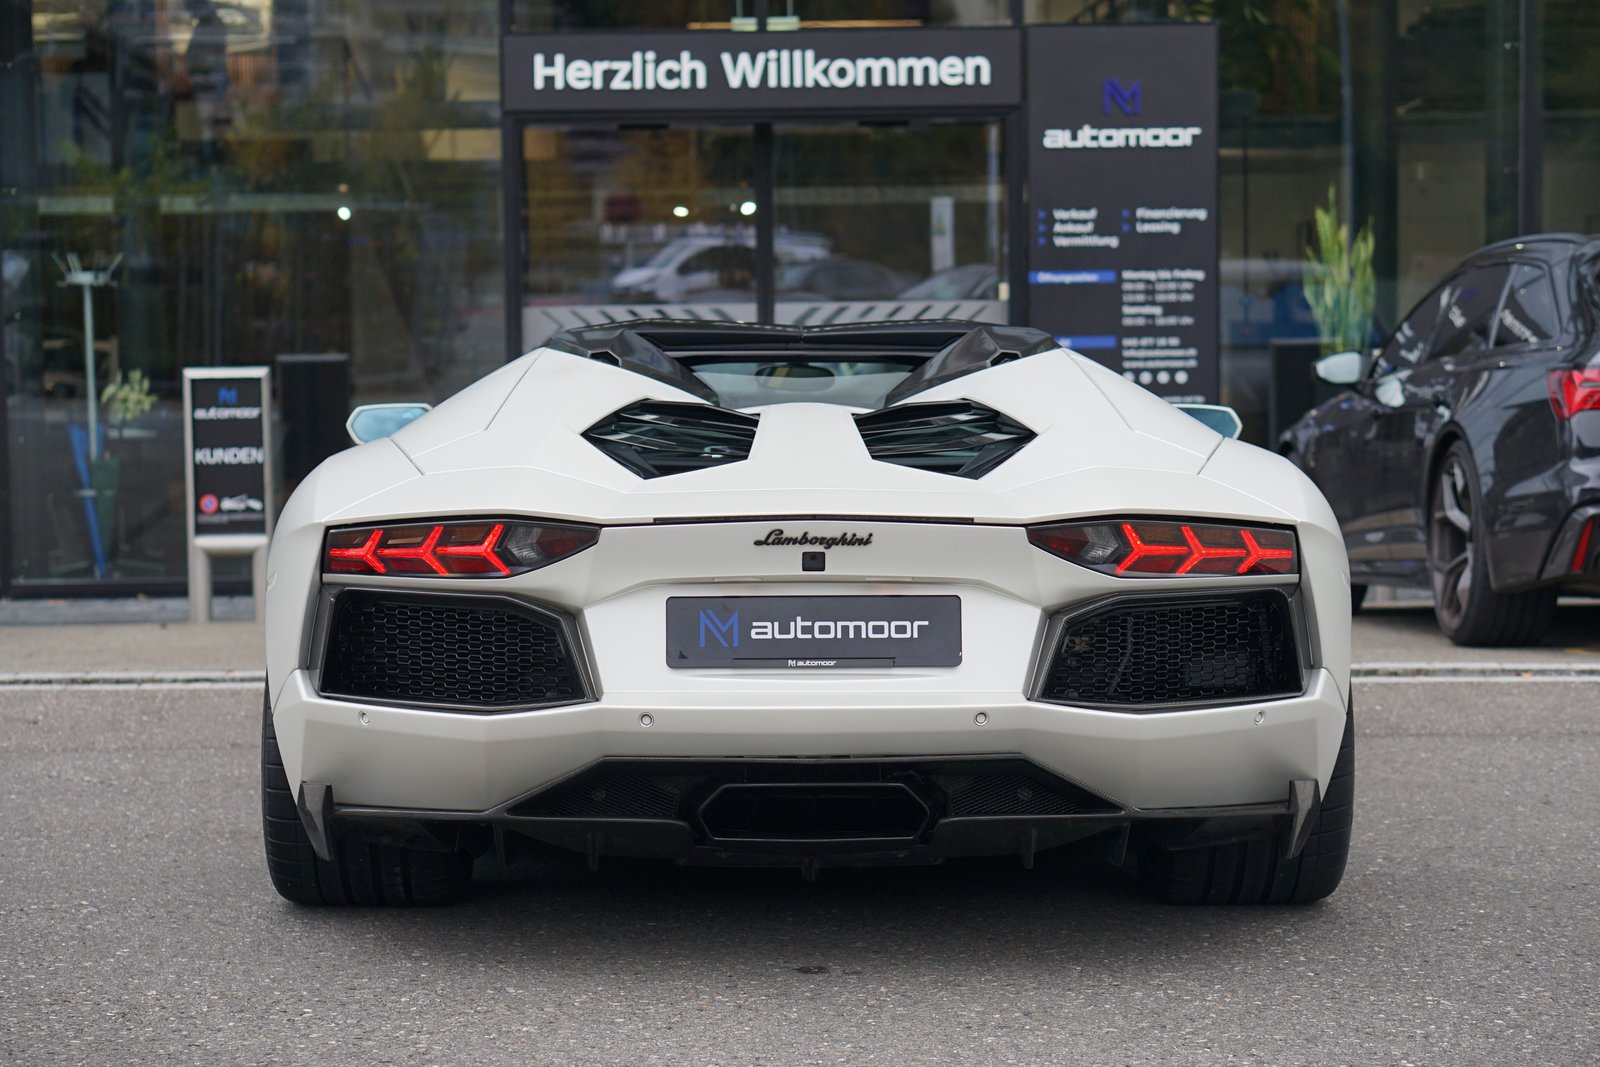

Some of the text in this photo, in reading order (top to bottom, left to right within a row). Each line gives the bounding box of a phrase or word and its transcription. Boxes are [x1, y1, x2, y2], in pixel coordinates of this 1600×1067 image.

[533, 50, 992, 91] Herzlich Willkommen
[1043, 125, 1203, 149] automoor
[1053, 208, 1098, 220] Verkauf
[1135, 207, 1208, 220] Finanzierung
[1053, 221, 1094, 233] Ankauf
[1135, 221, 1181, 234] Leasing
[1053, 235, 1120, 248] Vermittlung
[194, 405, 261, 420] automoor
[195, 447, 264, 465] KUNDEN
[754, 529, 873, 549] Lamborghini
[751, 616, 929, 640] automoor
[796, 660, 837, 668] automoor
